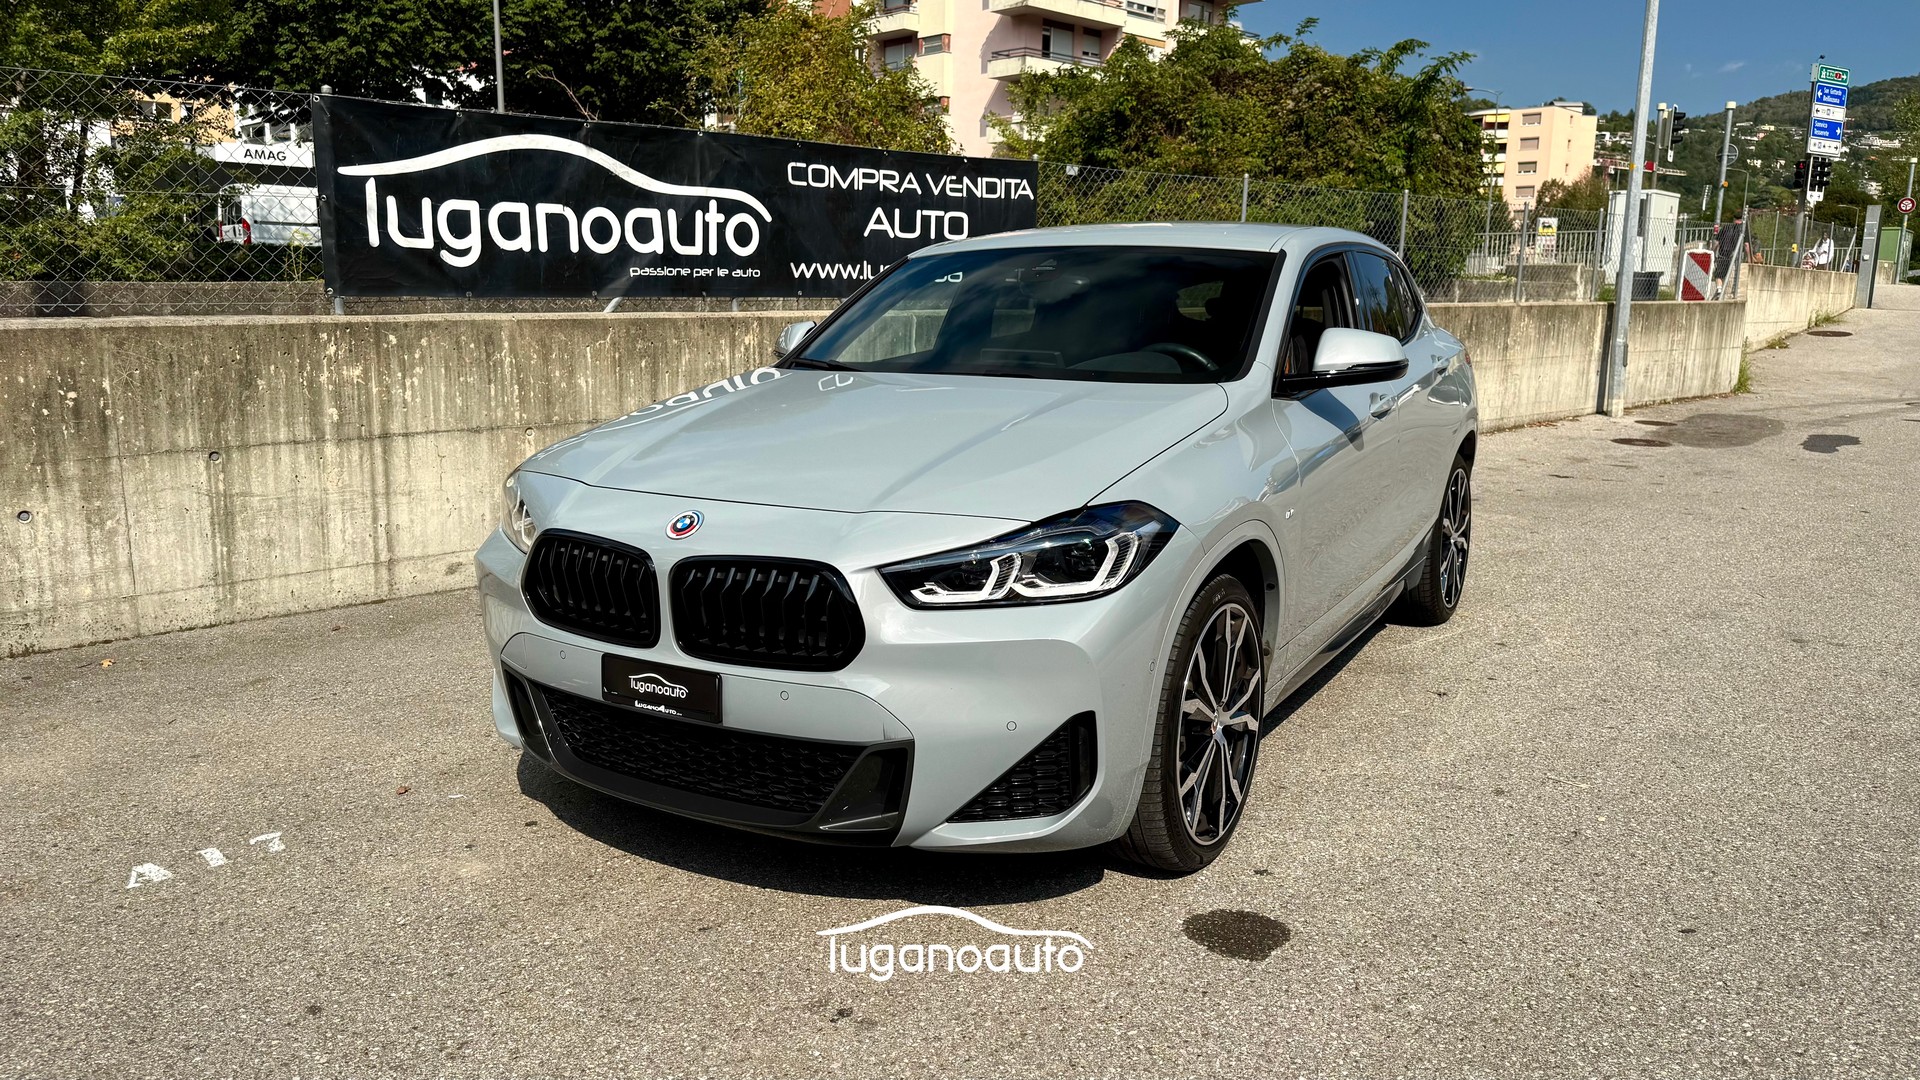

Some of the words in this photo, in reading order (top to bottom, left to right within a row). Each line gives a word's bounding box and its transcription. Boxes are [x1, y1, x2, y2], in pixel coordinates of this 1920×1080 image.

[244, 149, 287, 161] AMAG
[787, 161, 922, 196] COMPRA
[925, 172, 1035, 202] VENDITA
[365, 176, 761, 268] luganoauto
[863, 206, 970, 240] AUTO
[629, 267, 692, 278] passione
[693, 268, 715, 278] per
[716, 266, 729, 277] le
[731, 267, 761, 278] auto
[630, 677, 687, 699] luganoauto
